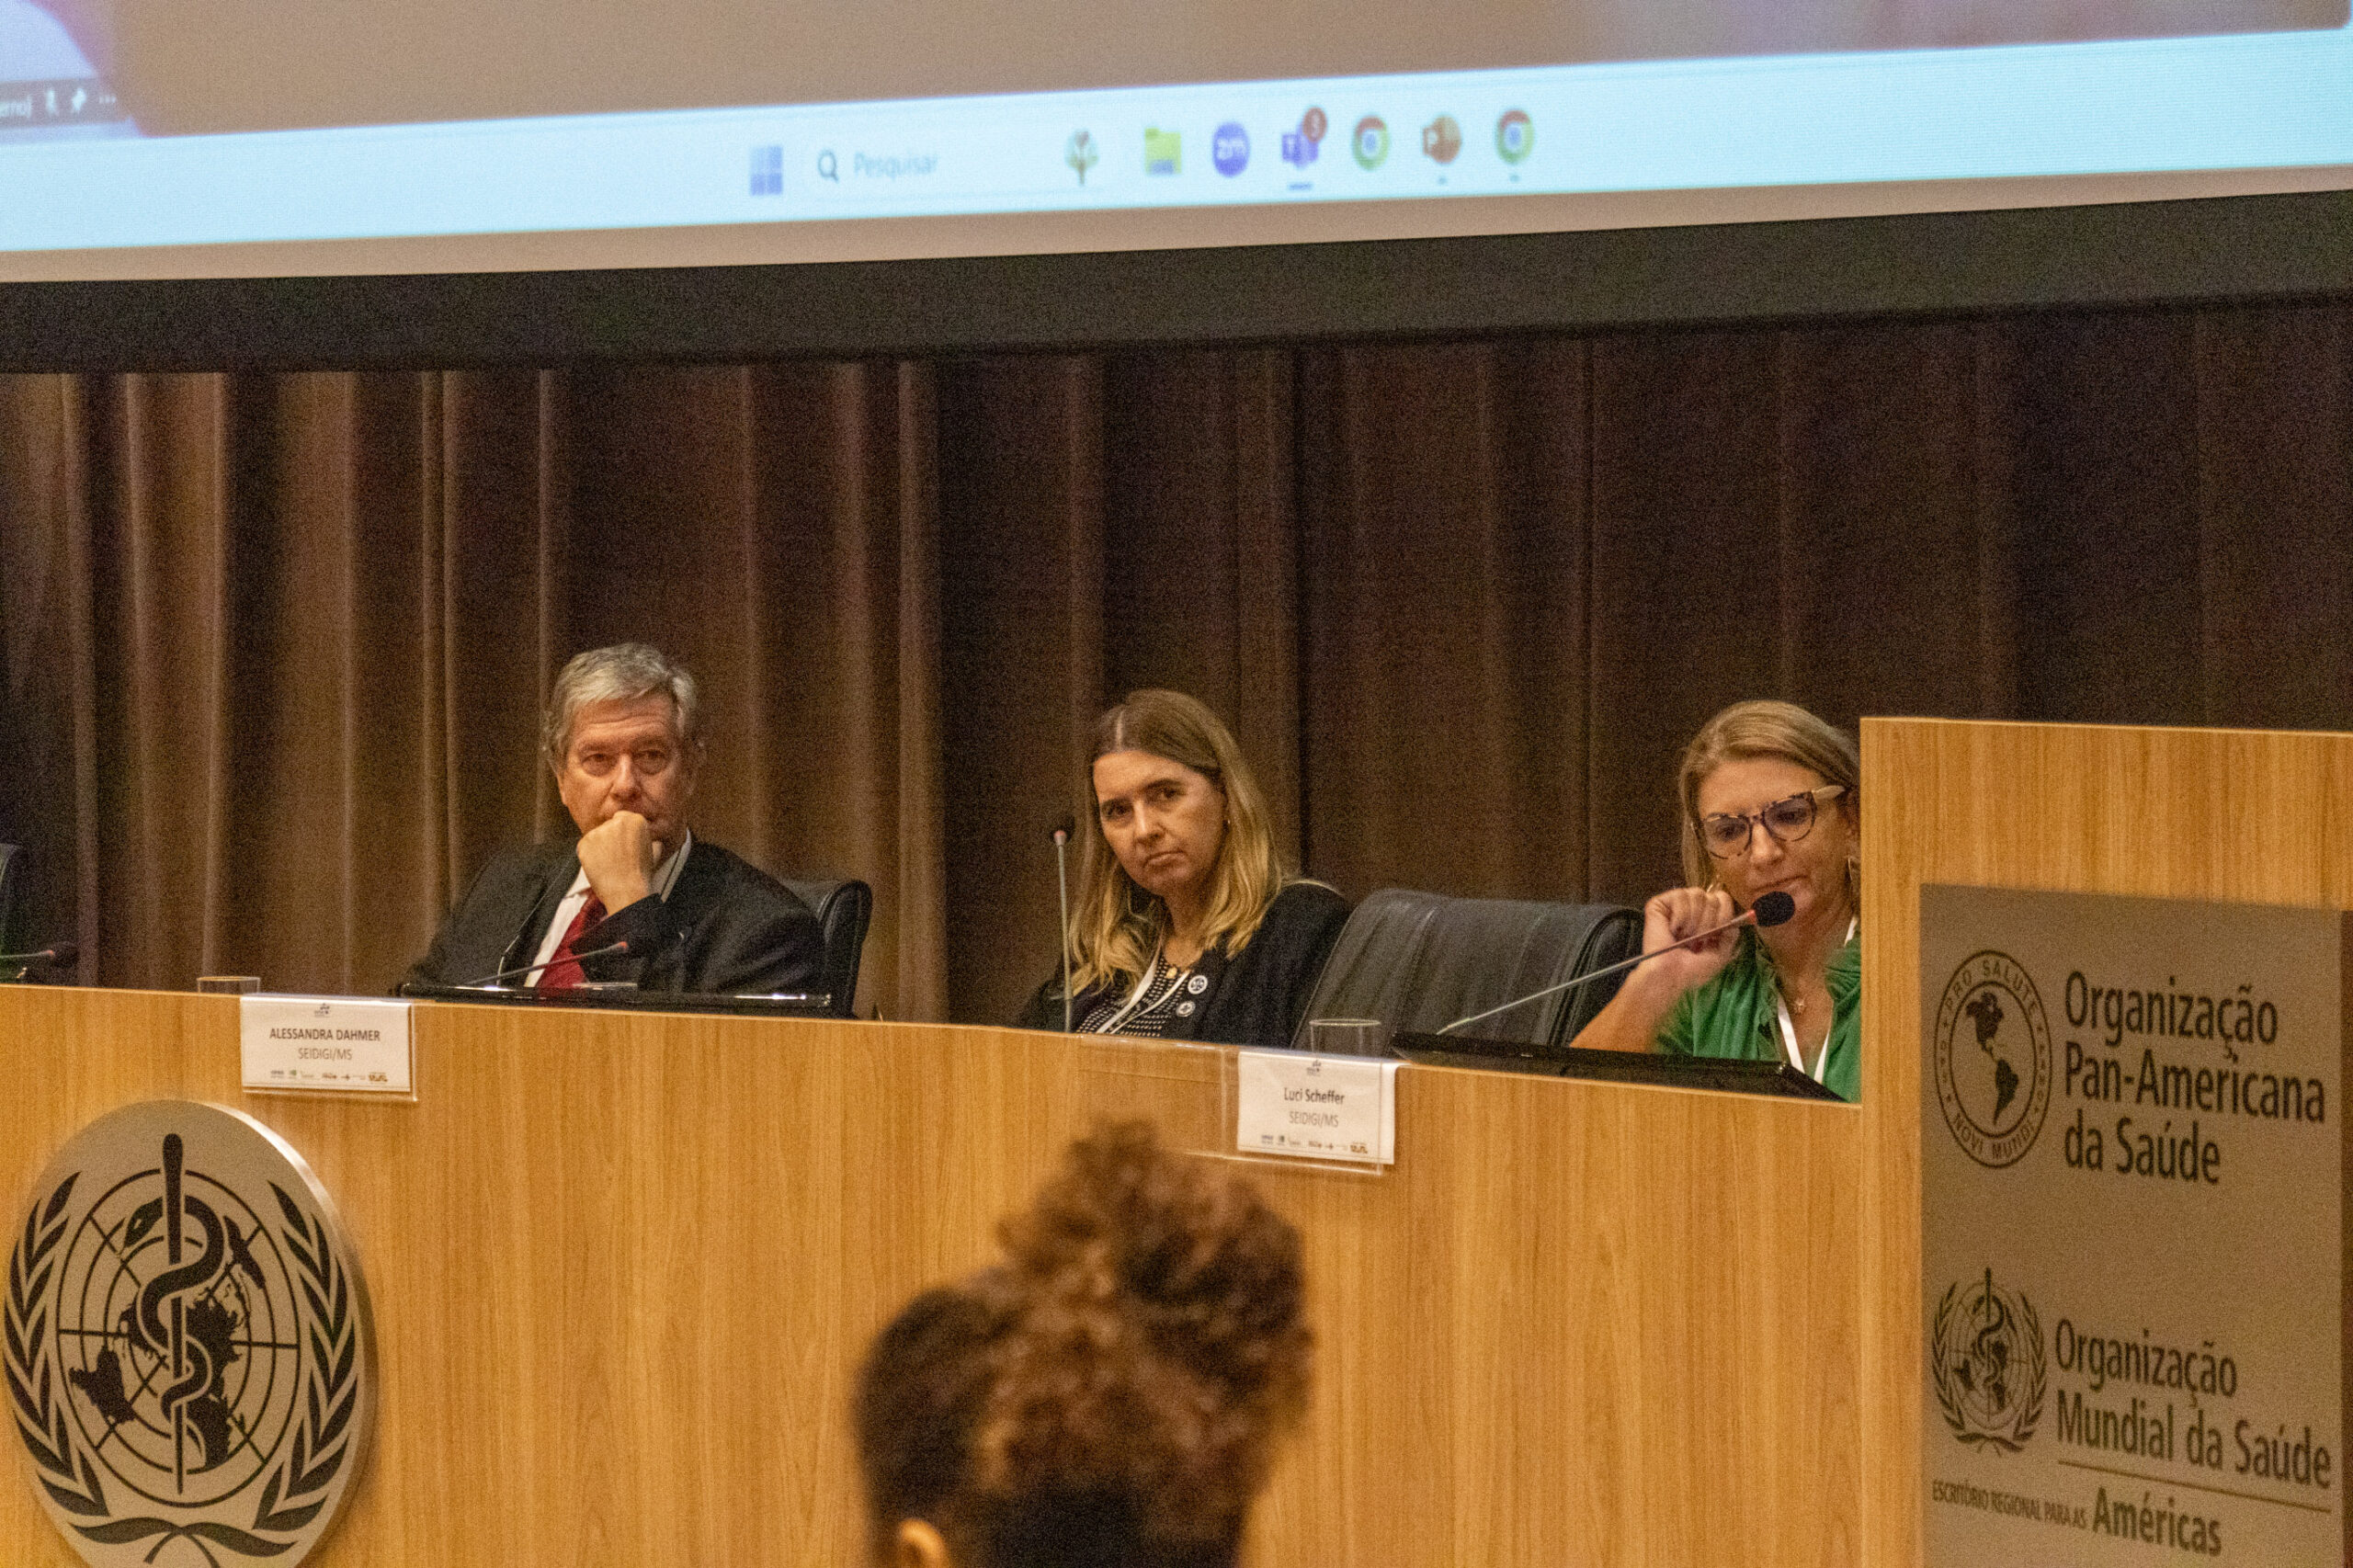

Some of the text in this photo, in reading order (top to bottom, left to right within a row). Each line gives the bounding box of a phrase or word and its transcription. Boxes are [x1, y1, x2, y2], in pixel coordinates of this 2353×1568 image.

[269, 1028, 381, 1041] ALESSANDRA DAHMER
[2064, 971, 2278, 1060] Organização
[298, 1048, 353, 1062] SEIDIGI/MS
[2064, 1040, 2325, 1124] Pan-Americana
[1284, 1087, 1346, 1105] Luci Scheffer
[1289, 1110, 1339, 1128] SEIDIGI/MS
[2064, 1108, 2220, 1184] da Saúde
[2055, 1319, 2237, 1407] Organização
[2057, 1389, 2331, 1490] Mundial da Saúde
[1991, 1490, 2041, 1521] REGIONAL
[2044, 1501, 2070, 1527] PARA
[2072, 1506, 2086, 1529] AS
[2091, 1486, 2222, 1557] Américas
